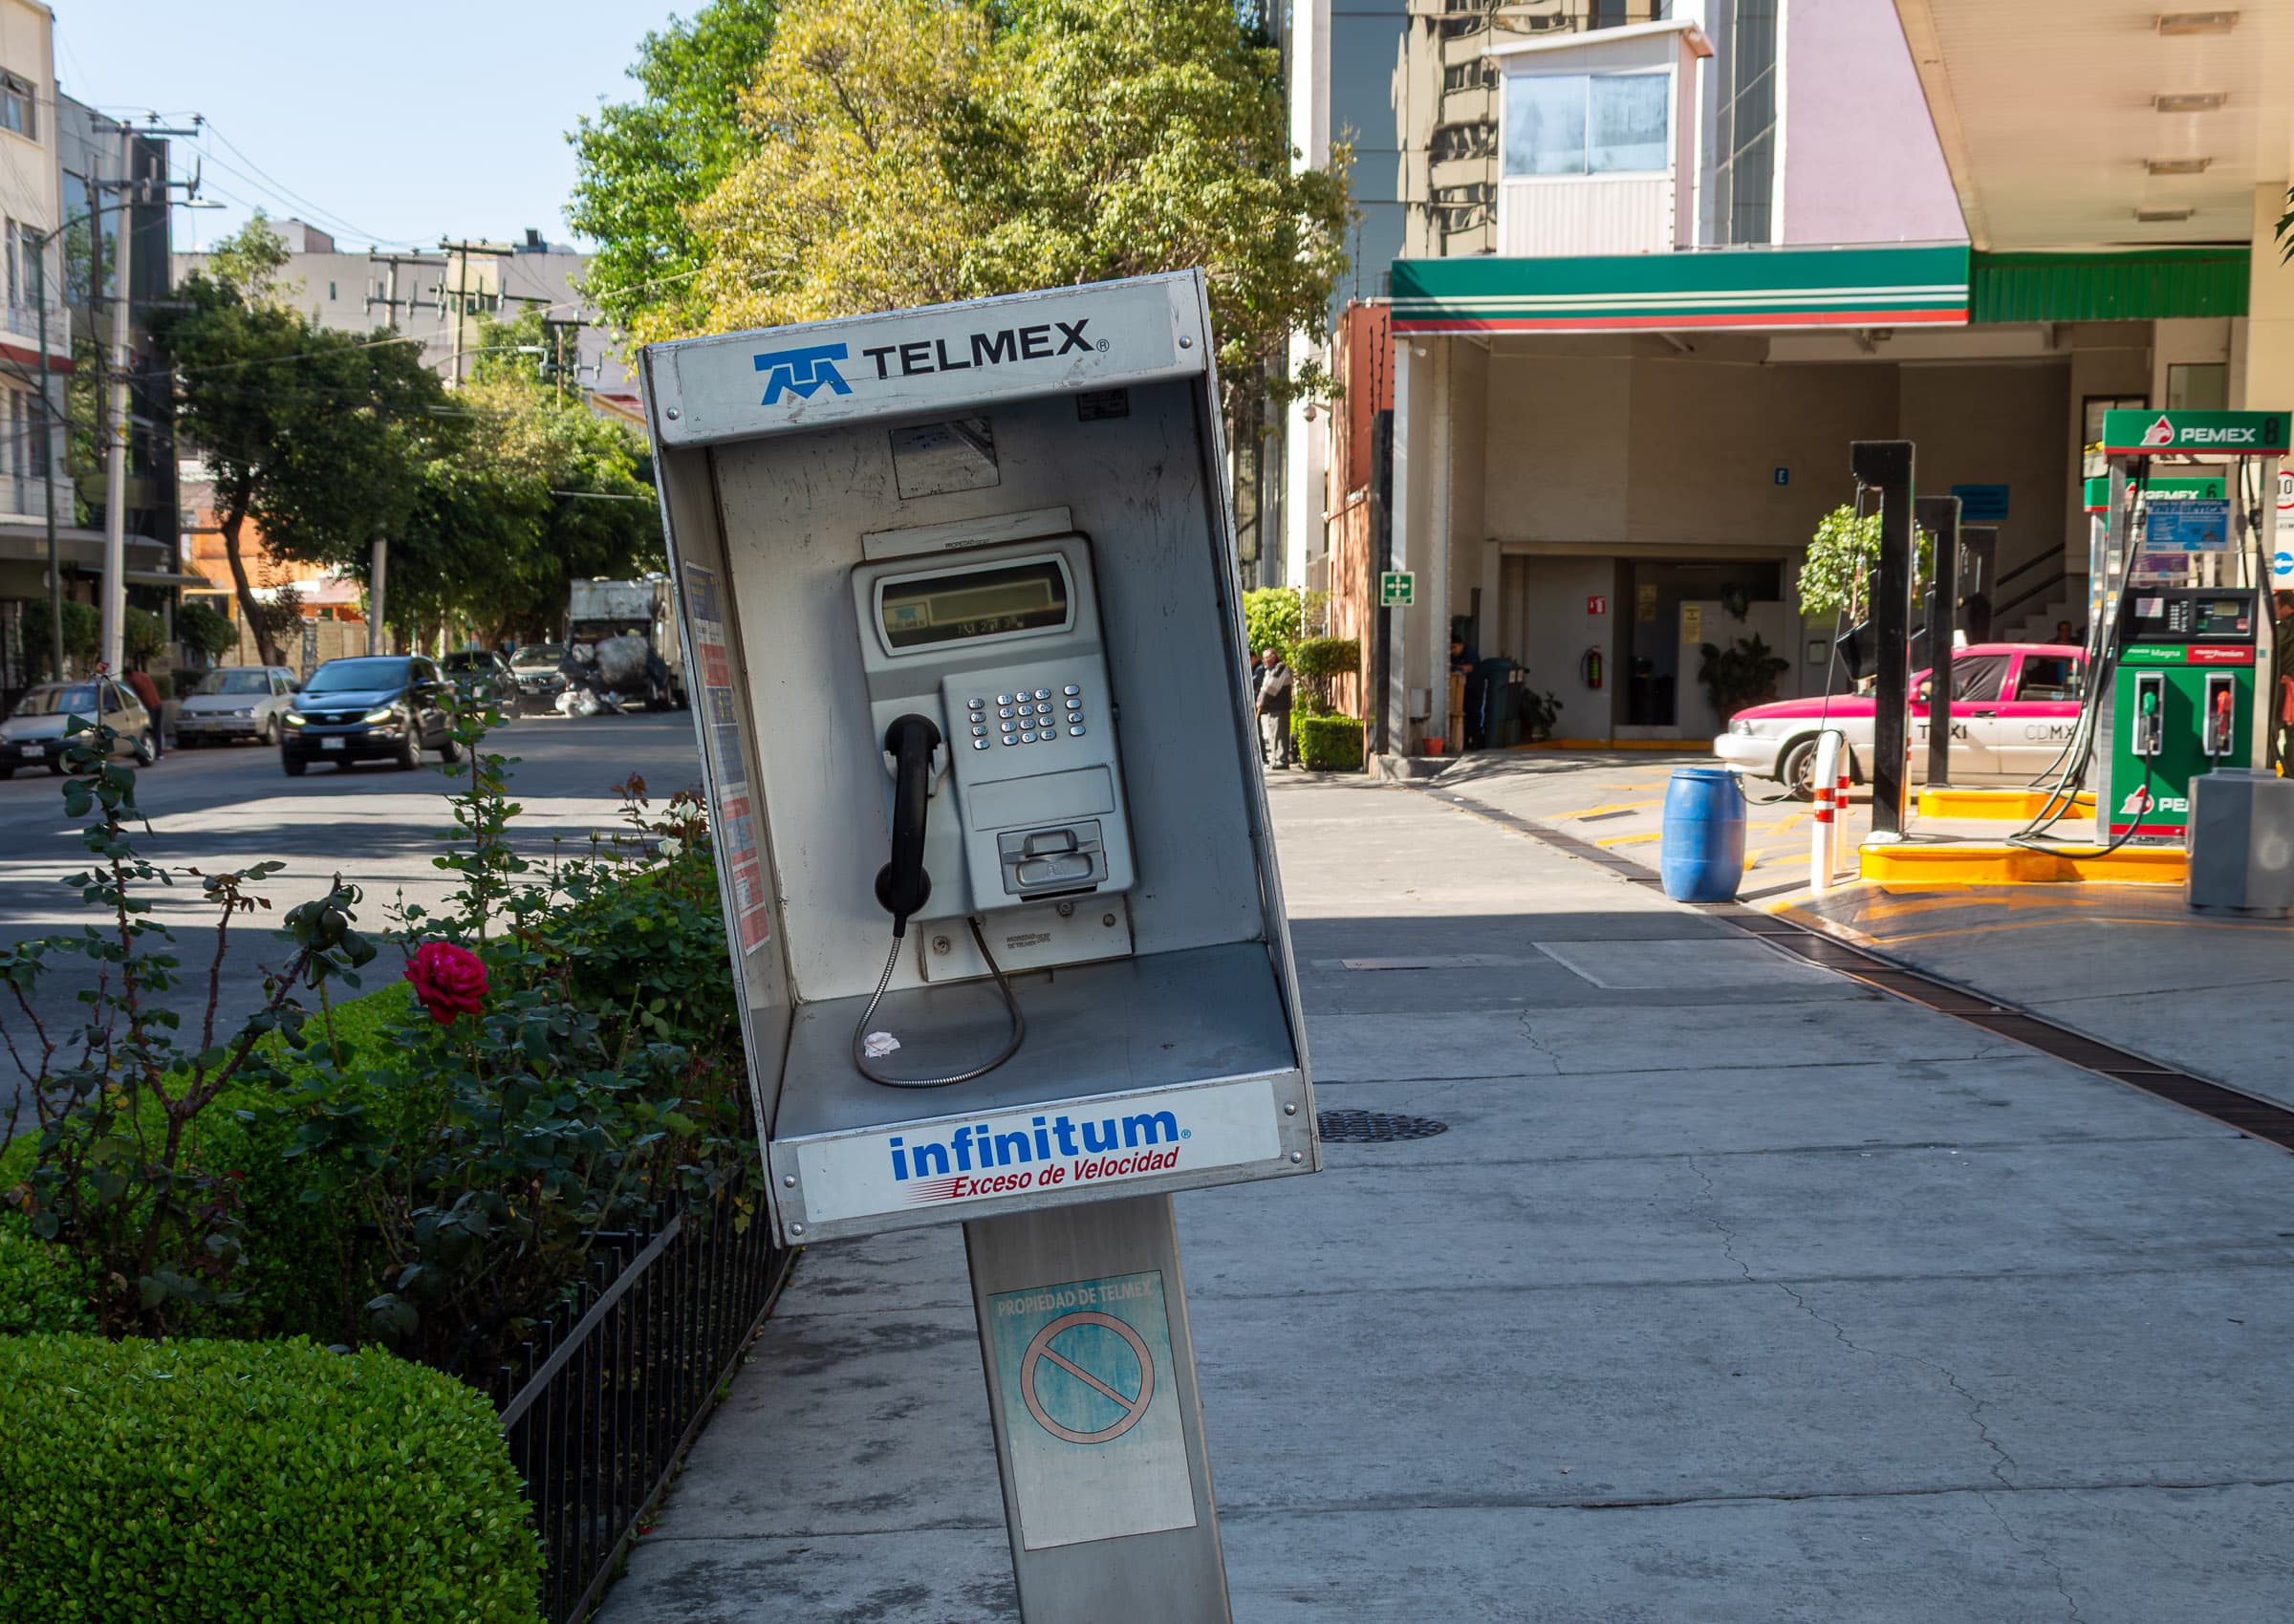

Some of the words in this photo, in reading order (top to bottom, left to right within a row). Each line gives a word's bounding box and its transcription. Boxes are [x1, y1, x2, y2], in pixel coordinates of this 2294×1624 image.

[2180, 427, 2256, 443] PEMEX
[2263, 417, 2280, 444] 8
[2206, 483, 2217, 499] 6
[1916, 725, 1968, 739] TXI
[2024, 725, 2075, 740] CDMX
[953, 1172, 1031, 1199] Exceso
[1038, 1163, 1065, 1186] de
[1073, 1146, 1180, 1180] Velocidad
[997, 1292, 1075, 1316] PROPIEDAD
[1077, 1288, 1097, 1306] DE
[1099, 1280, 1154, 1302] TELMEX
